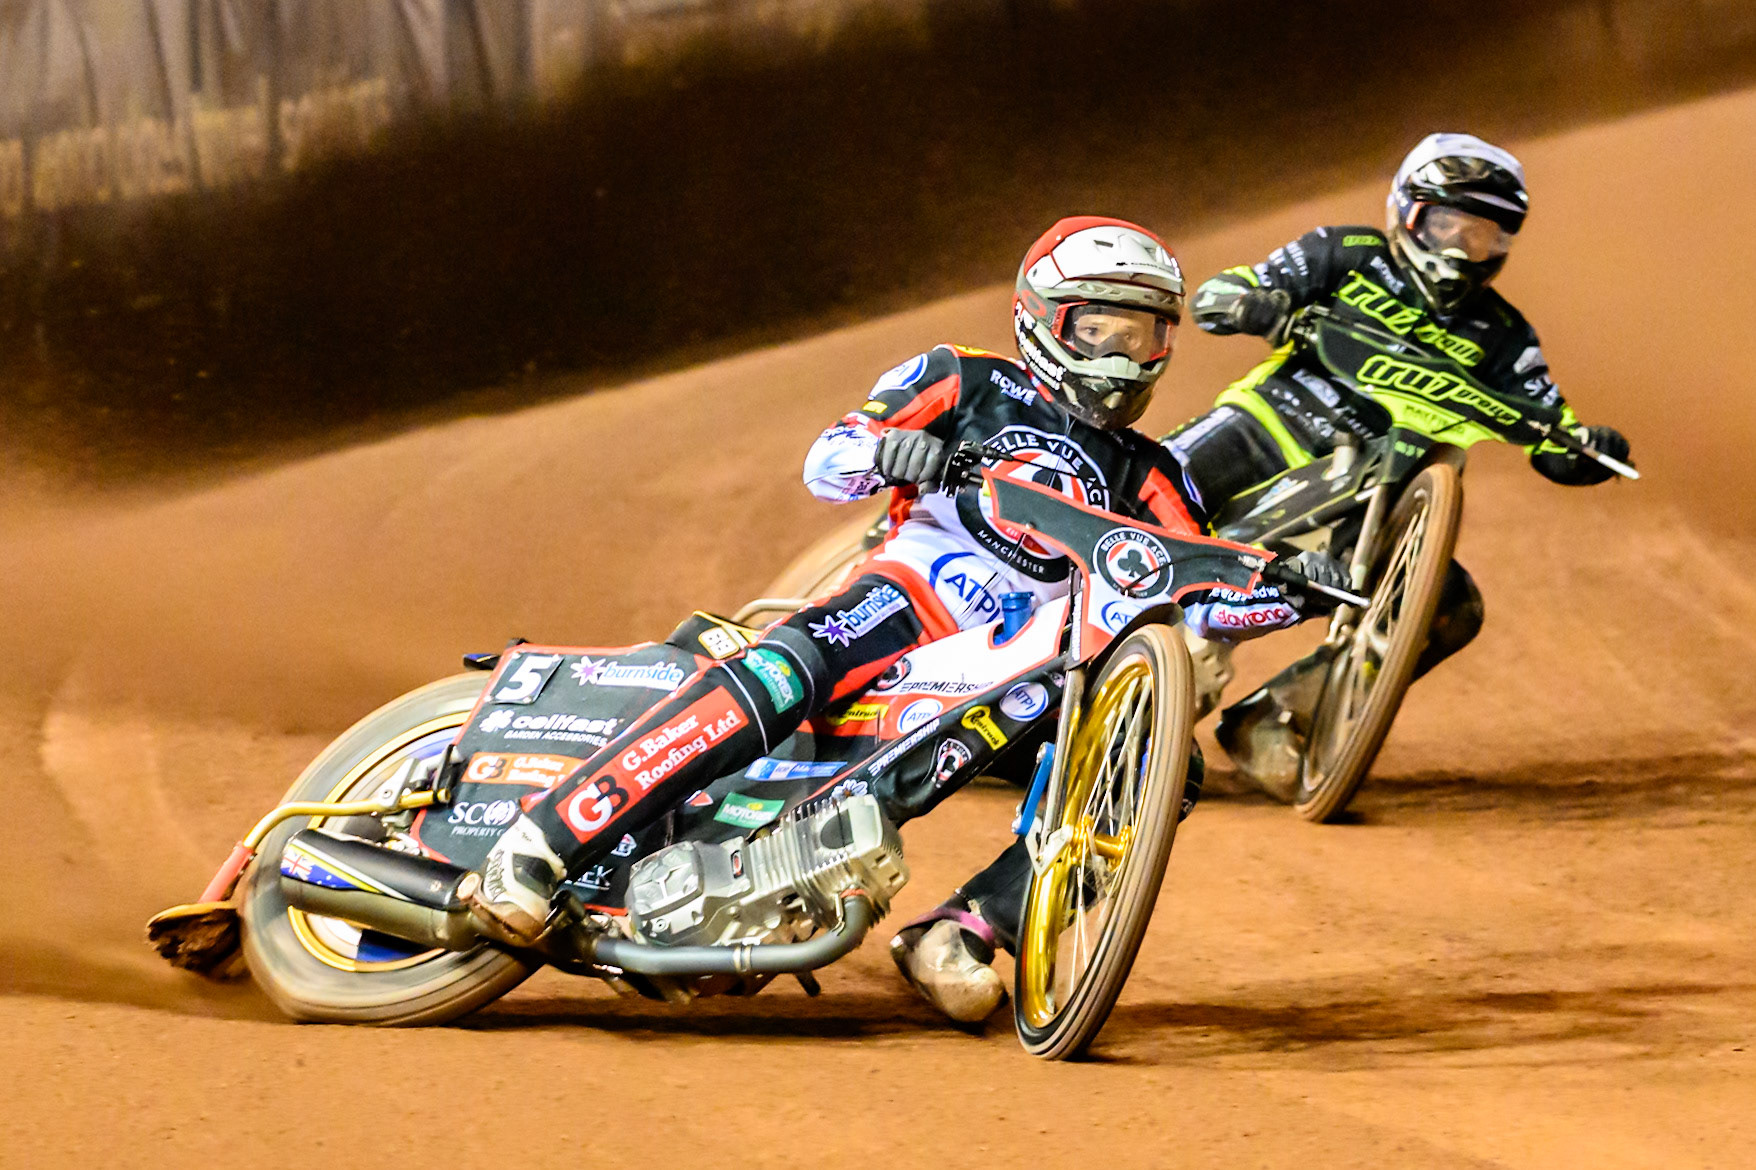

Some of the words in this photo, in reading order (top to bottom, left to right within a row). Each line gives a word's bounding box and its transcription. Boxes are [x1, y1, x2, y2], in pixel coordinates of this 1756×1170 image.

[990, 369, 1037, 399] ROWE
[1046, 440, 1084, 471] VUE
[1086, 477, 1104, 509] AC
[977, 529, 1045, 574] MANCHESTER
[1100, 532, 1127, 551] BELLE
[1130, 533, 1150, 546] VUE
[943, 572, 1001, 624] ATPI
[496, 656, 553, 701] 5
[603, 661, 684, 684] burnside
[622, 715, 700, 771] G.Baker
[634, 735, 708, 791] Roofing
[702, 709, 741, 742] Ltd
[876, 718, 941, 772] PREMIERSHIP
[468, 756, 507, 780] GB
[567, 774, 630, 832] GB
